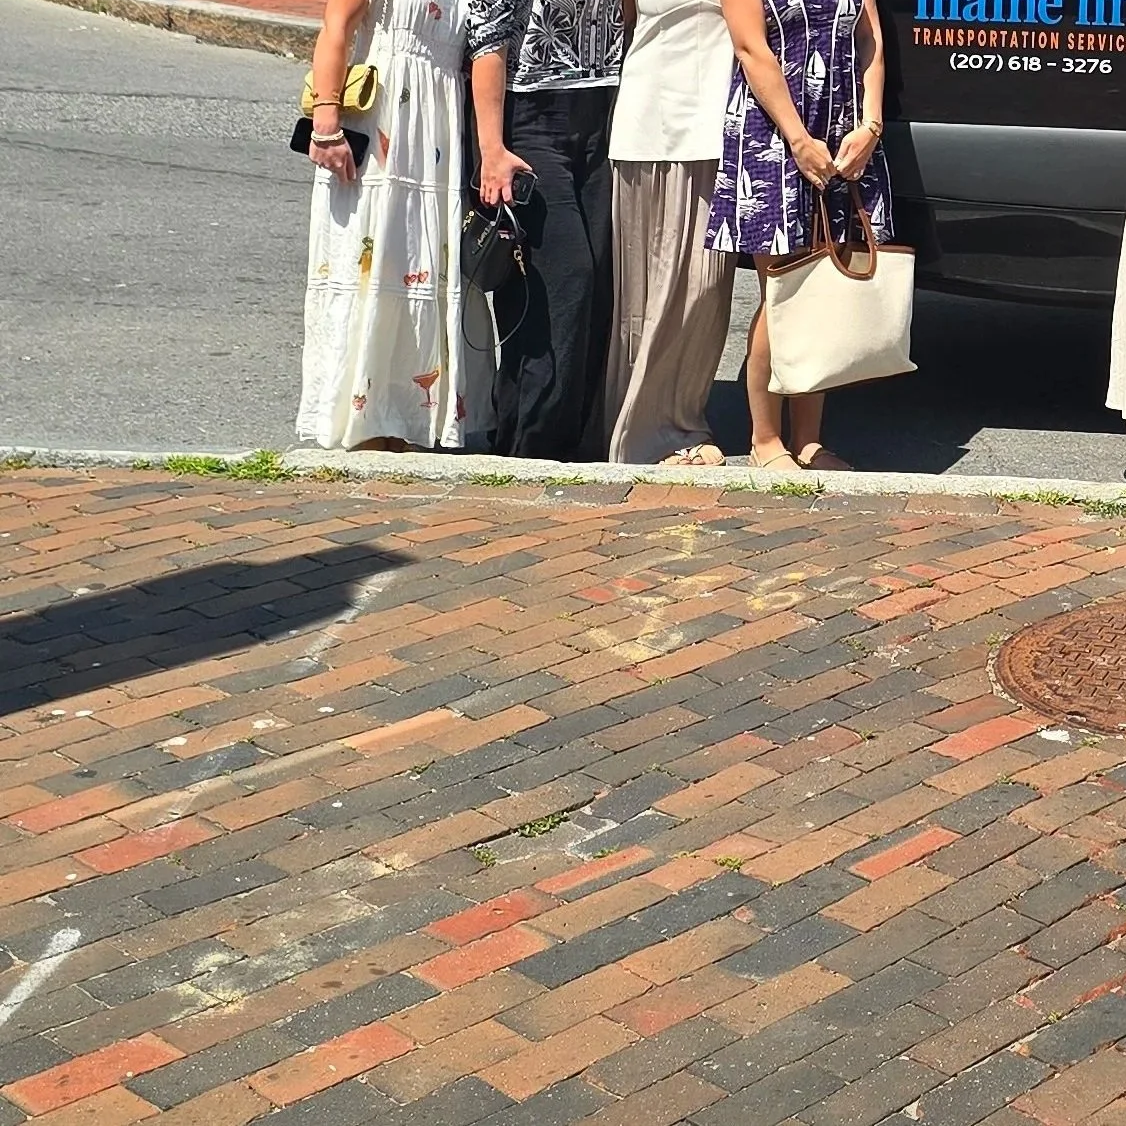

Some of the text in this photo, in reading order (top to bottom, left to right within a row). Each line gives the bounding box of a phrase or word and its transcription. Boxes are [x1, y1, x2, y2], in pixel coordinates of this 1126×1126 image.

[913, 27, 1060, 49] TRANSPORTATION
[949, 52, 1004, 71] (207)
[1008, 56, 1042, 72] 618
[1061, 58, 1113, 74] 3276
